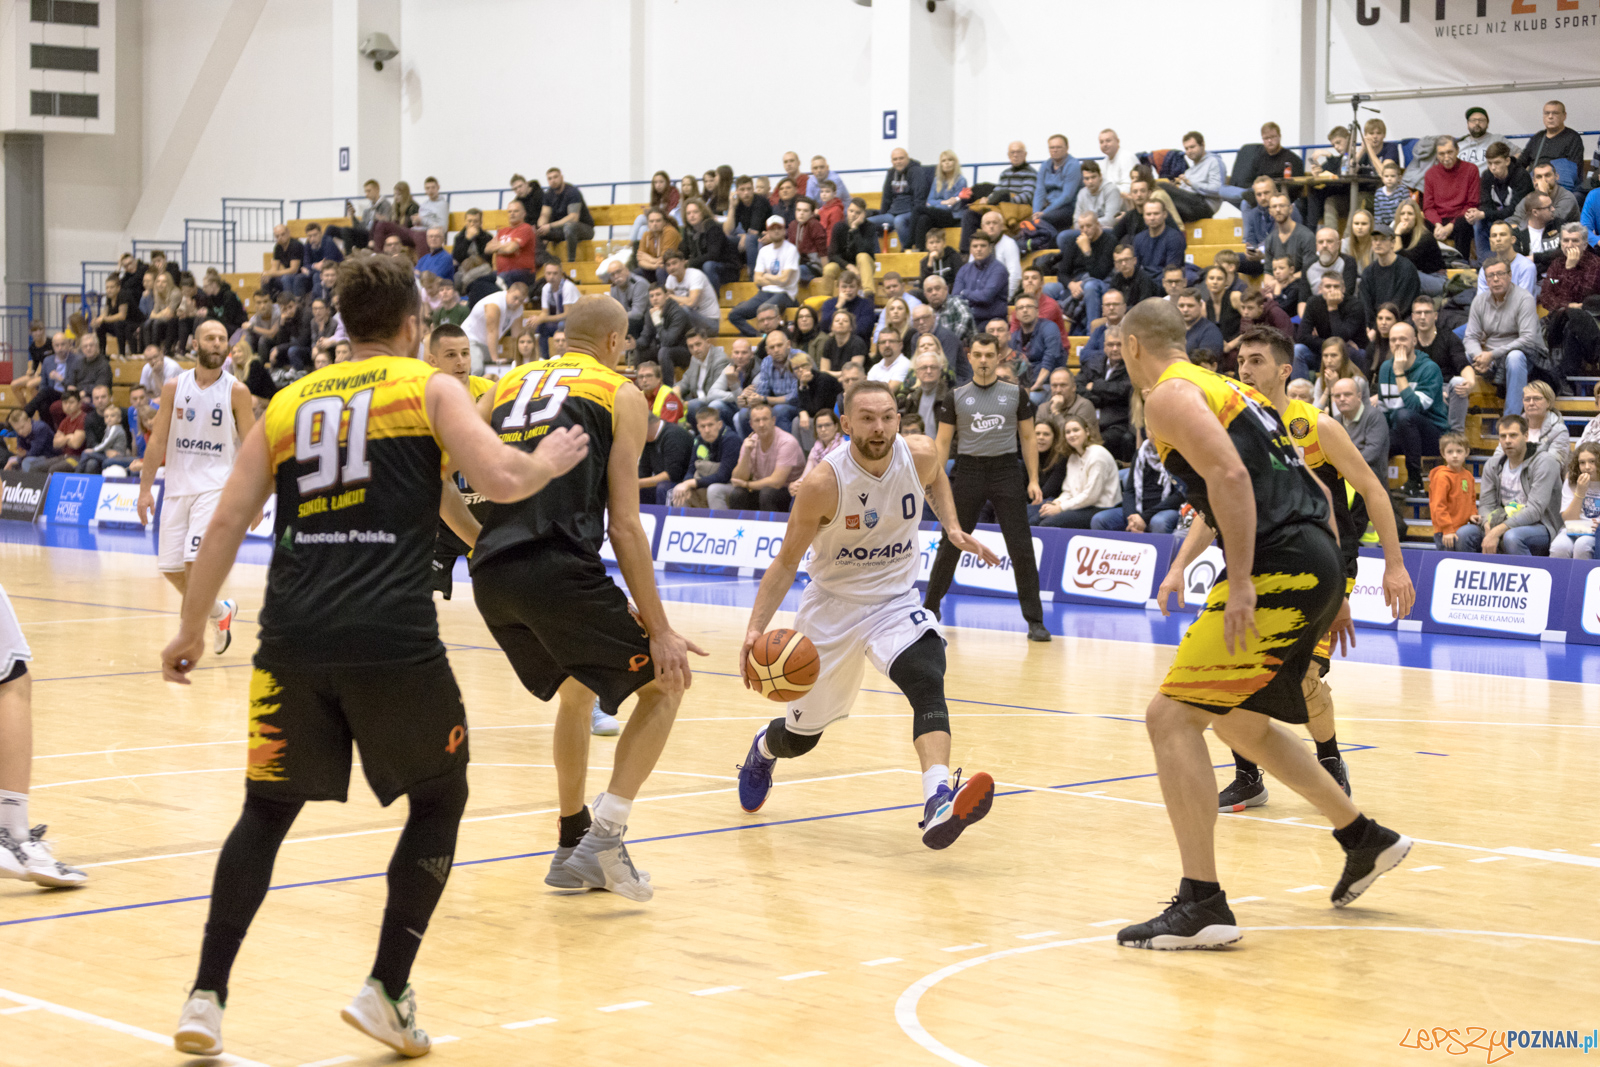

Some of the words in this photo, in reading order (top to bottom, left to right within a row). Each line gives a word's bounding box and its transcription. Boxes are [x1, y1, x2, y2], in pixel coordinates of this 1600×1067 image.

[1435, 24, 1479, 39] WIĘCEJ
[1486, 21, 1507, 34] NIŻ
[1514, 18, 1548, 32] KLUB
[885, 114, 896, 135] C
[299, 368, 388, 398] CZERWONKA
[501, 368, 583, 430] 15
[211, 408, 223, 427] 9
[976, 417, 999, 429] LOTTO
[294, 387, 375, 496] 91
[901, 493, 916, 520] 0
[295, 531, 346, 544] Anocote
[348, 530, 397, 544] Polska
[1096, 561, 1141, 580] Danuty
[1454, 570, 1531, 593] HELMEX
[1451, 593, 1528, 609] EXHIBITIONS
[1448, 612, 1479, 621] AGENCJA
[1480, 613, 1526, 624] REKLAMOWA
